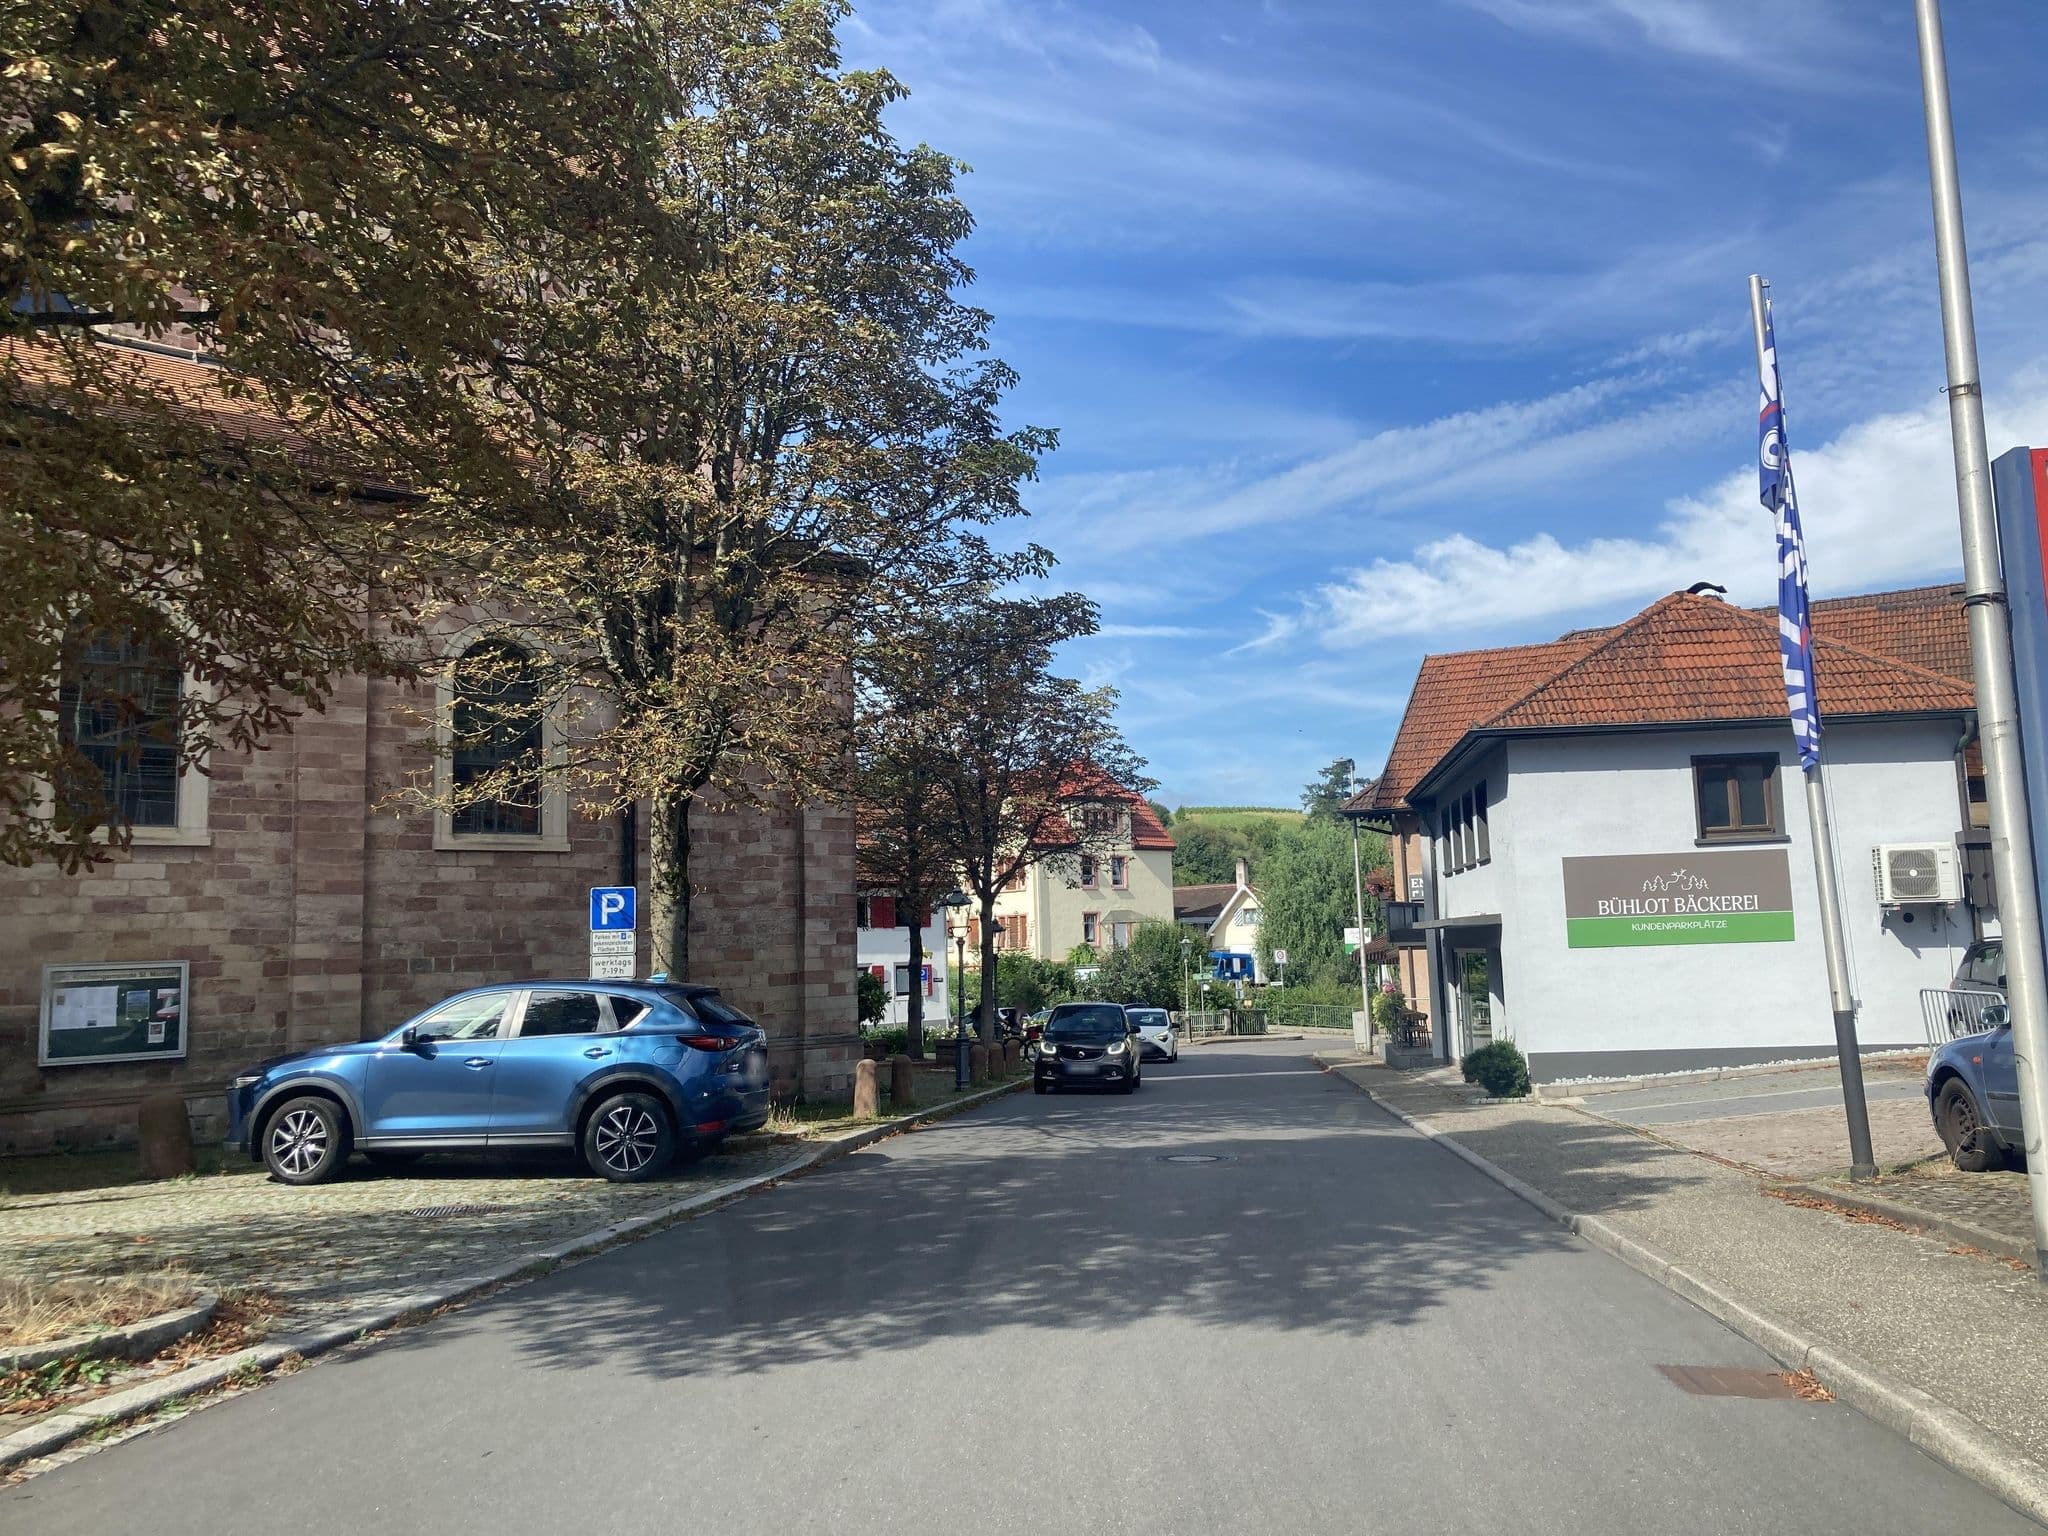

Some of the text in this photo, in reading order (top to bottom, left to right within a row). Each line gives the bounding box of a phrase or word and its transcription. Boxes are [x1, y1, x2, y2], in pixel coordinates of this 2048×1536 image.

[601, 893, 625, 926] P
[1598, 894, 1760, 916] BÜHLOT BÄCKEREI
[1631, 920, 1728, 932] KUNDENPARKPLÄTZE
[595, 959, 632, 967] werktags
